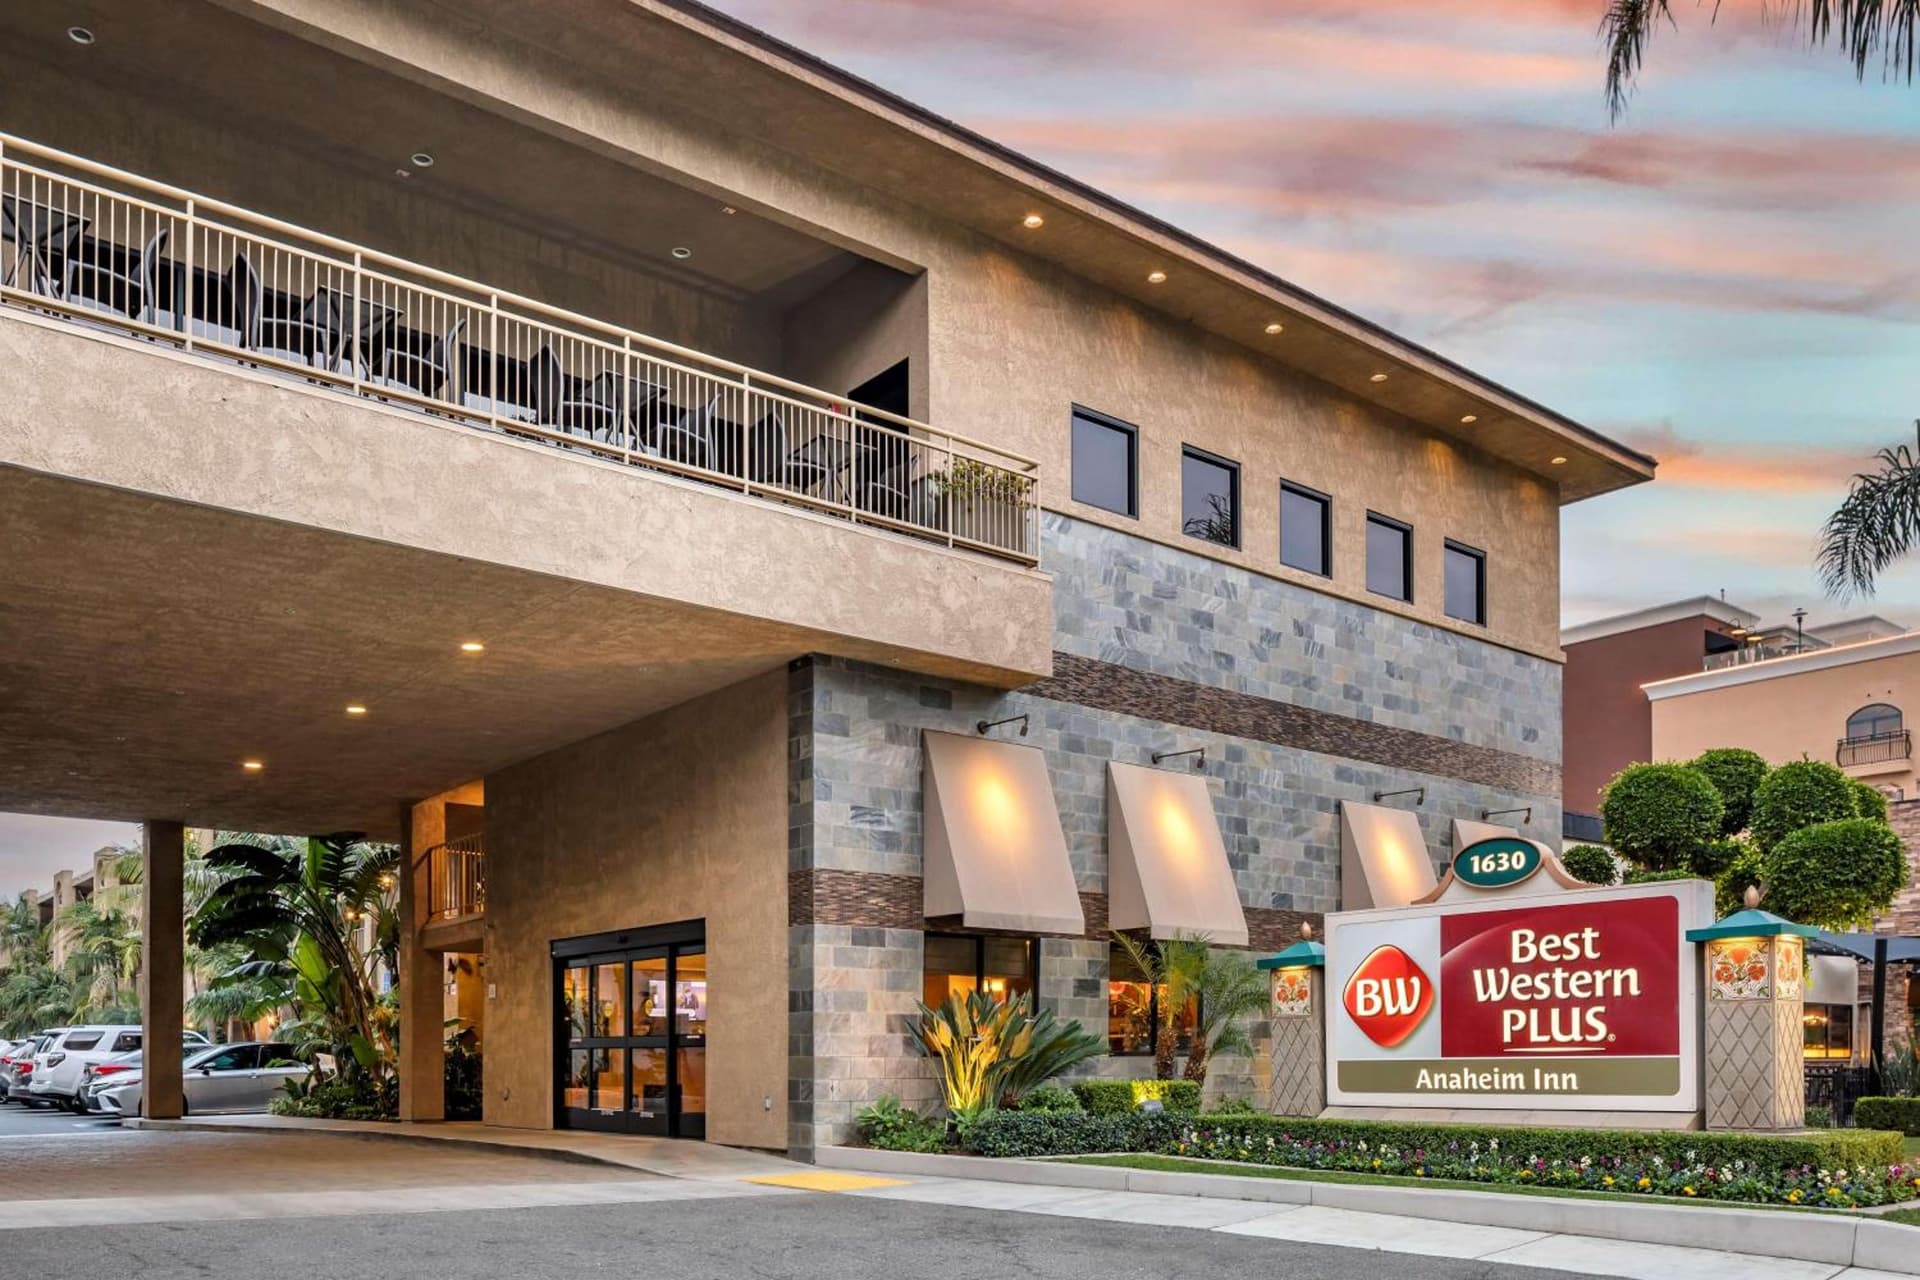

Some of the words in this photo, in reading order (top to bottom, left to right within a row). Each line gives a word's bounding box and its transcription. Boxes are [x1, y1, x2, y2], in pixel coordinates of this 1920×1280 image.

[1470, 850, 1526, 874] 1630
[1511, 927, 1601, 964] Best
[1355, 977, 1422, 1018] BW
[1473, 966, 1641, 1003] Western
[1416, 1068, 1526, 1091] Anaheim
[1534, 1069, 1579, 1091] Inn
